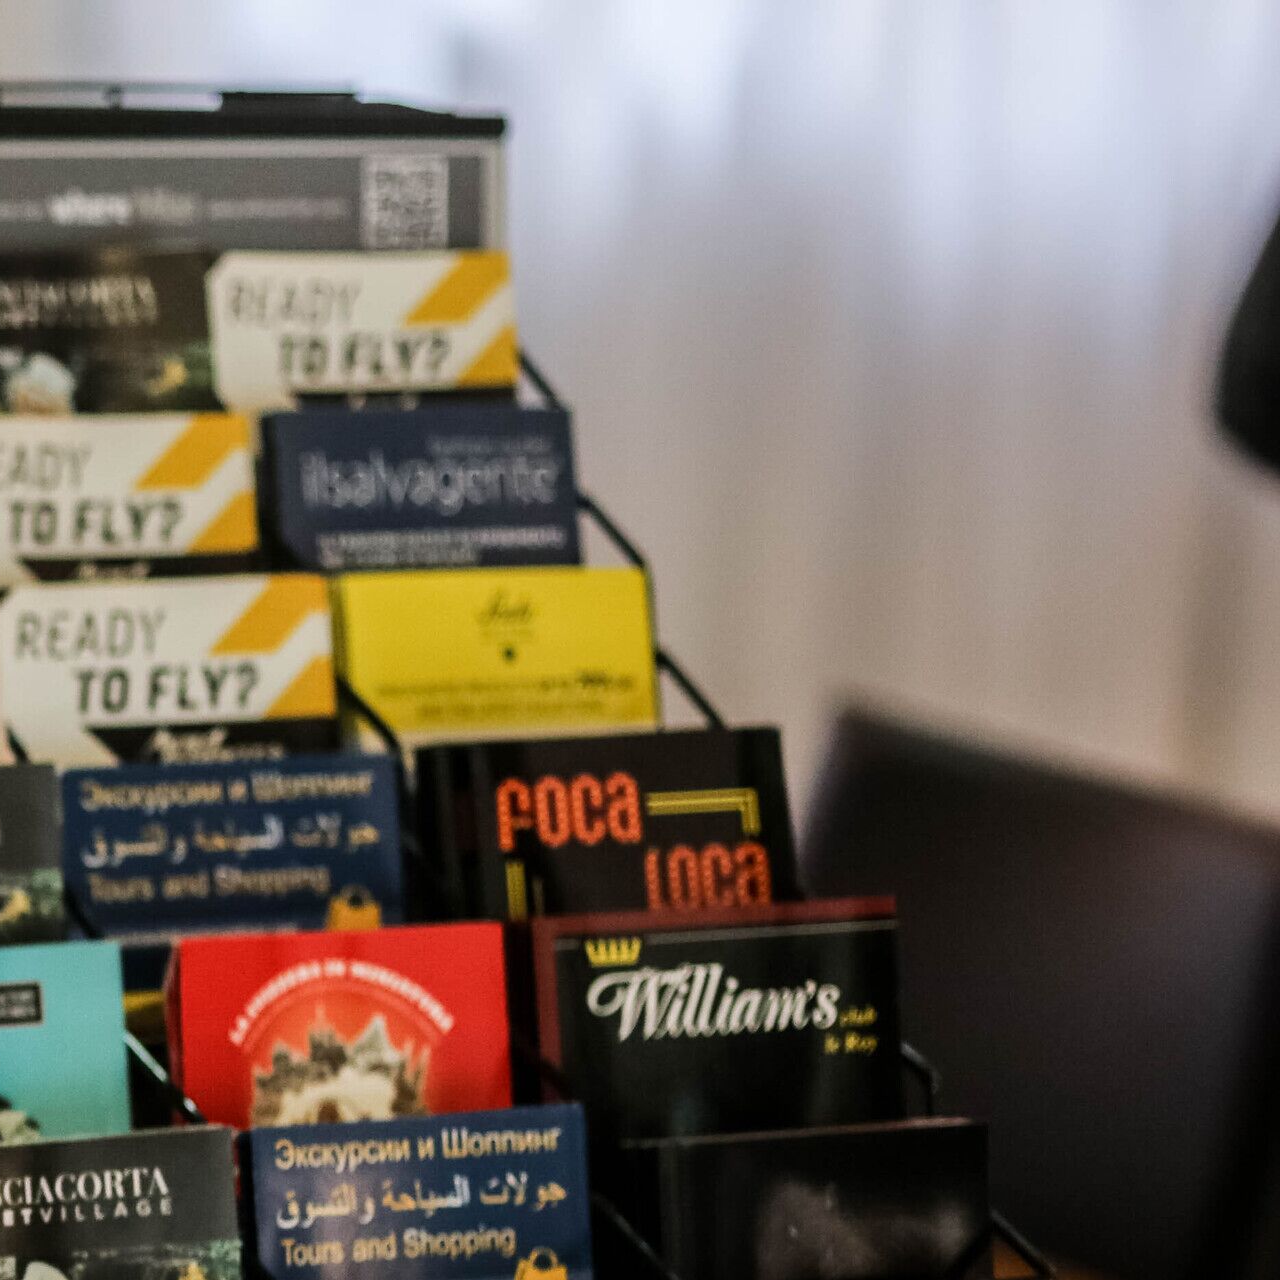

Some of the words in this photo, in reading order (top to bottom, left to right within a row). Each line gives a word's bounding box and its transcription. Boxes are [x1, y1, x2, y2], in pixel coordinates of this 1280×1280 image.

[10, 502, 60, 547] TO
[72, 499, 184, 547] FLY?
[14, 612, 166, 661] READY
[75, 665, 131, 716] TO
[145, 661, 260, 712] FLY?
[587, 962, 838, 1043] William's
[274, 1136, 410, 1173] Экскурсии
[417, 1136, 436, 1161] и
[442, 1126, 561, 1161] Шоппинг
[281, 1238, 347, 1267] Tours
[354, 1234, 395, 1263] and
[403, 1226, 517, 1263] Shopping
